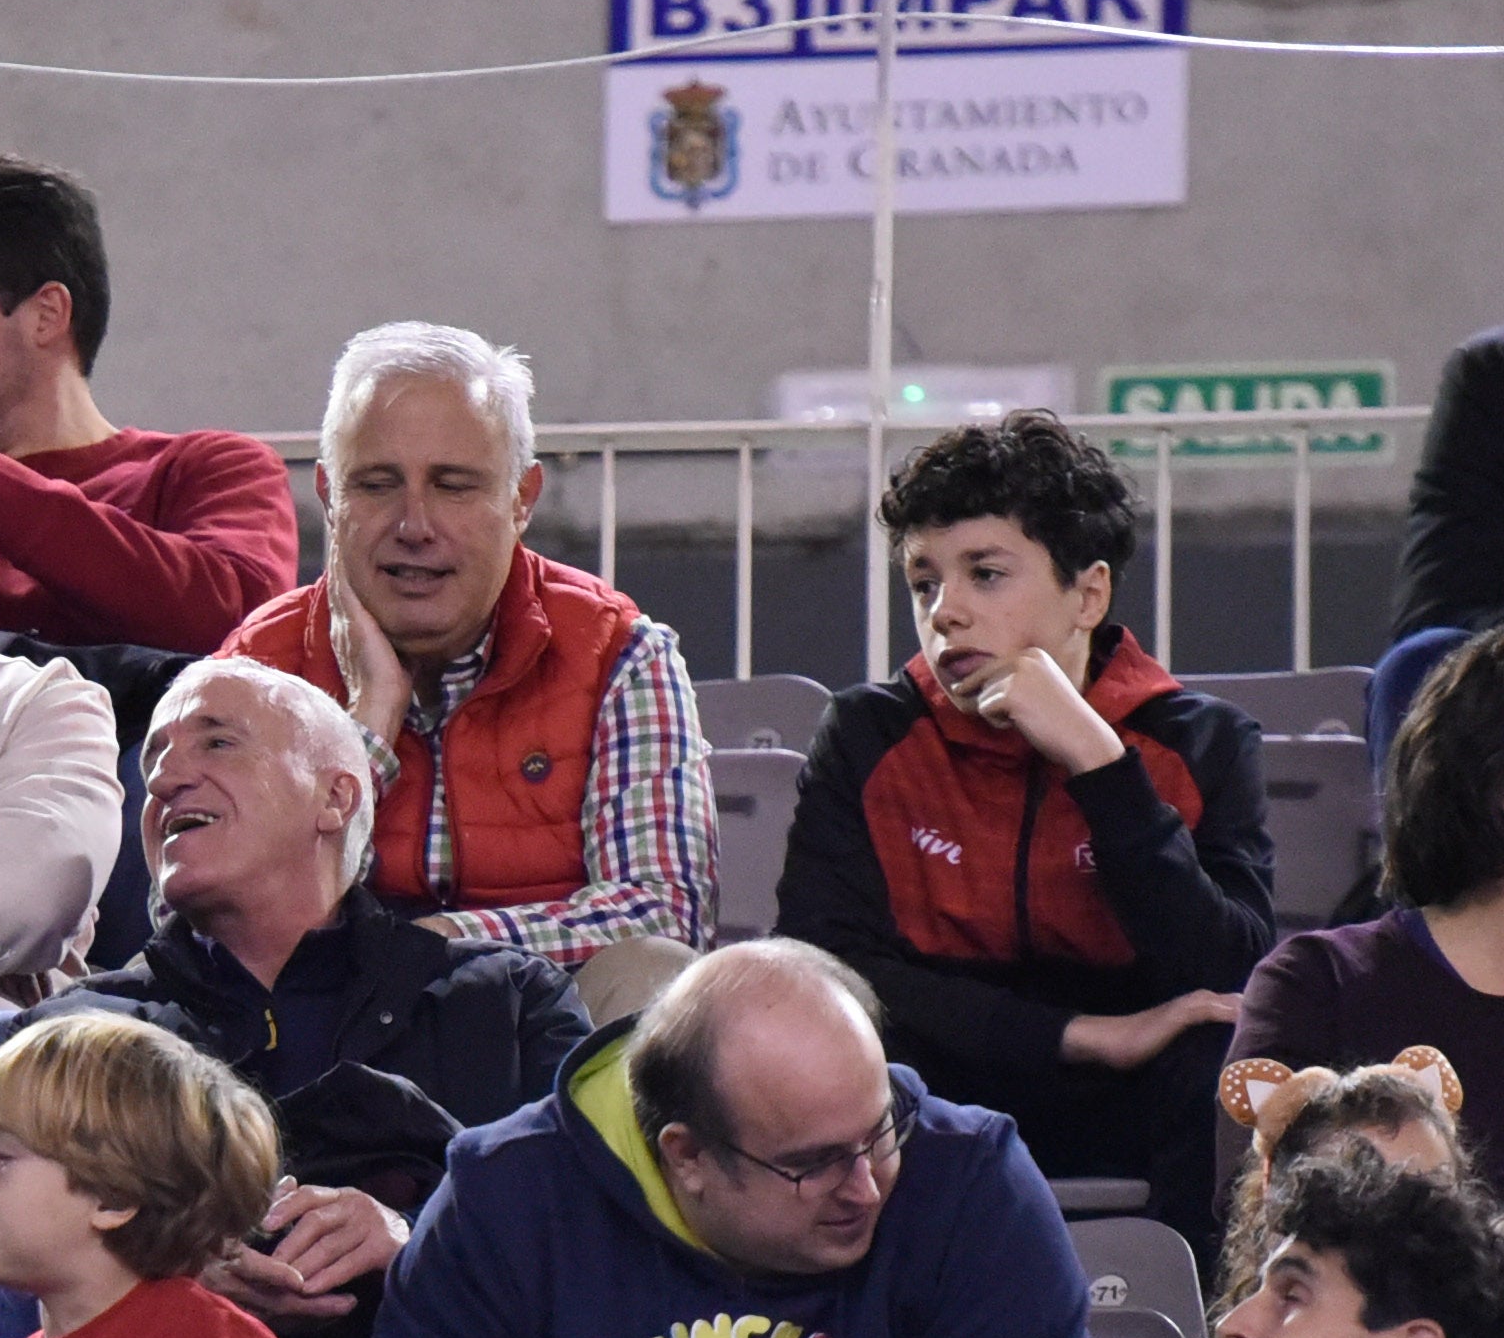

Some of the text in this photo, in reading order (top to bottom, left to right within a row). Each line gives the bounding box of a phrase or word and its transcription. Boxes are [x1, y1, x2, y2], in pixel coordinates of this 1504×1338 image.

[769, 141, 1080, 185] DE GRANADA
[1123, 380, 1362, 449] SALIDA
[1096, 1284, 1118, 1302] 71
